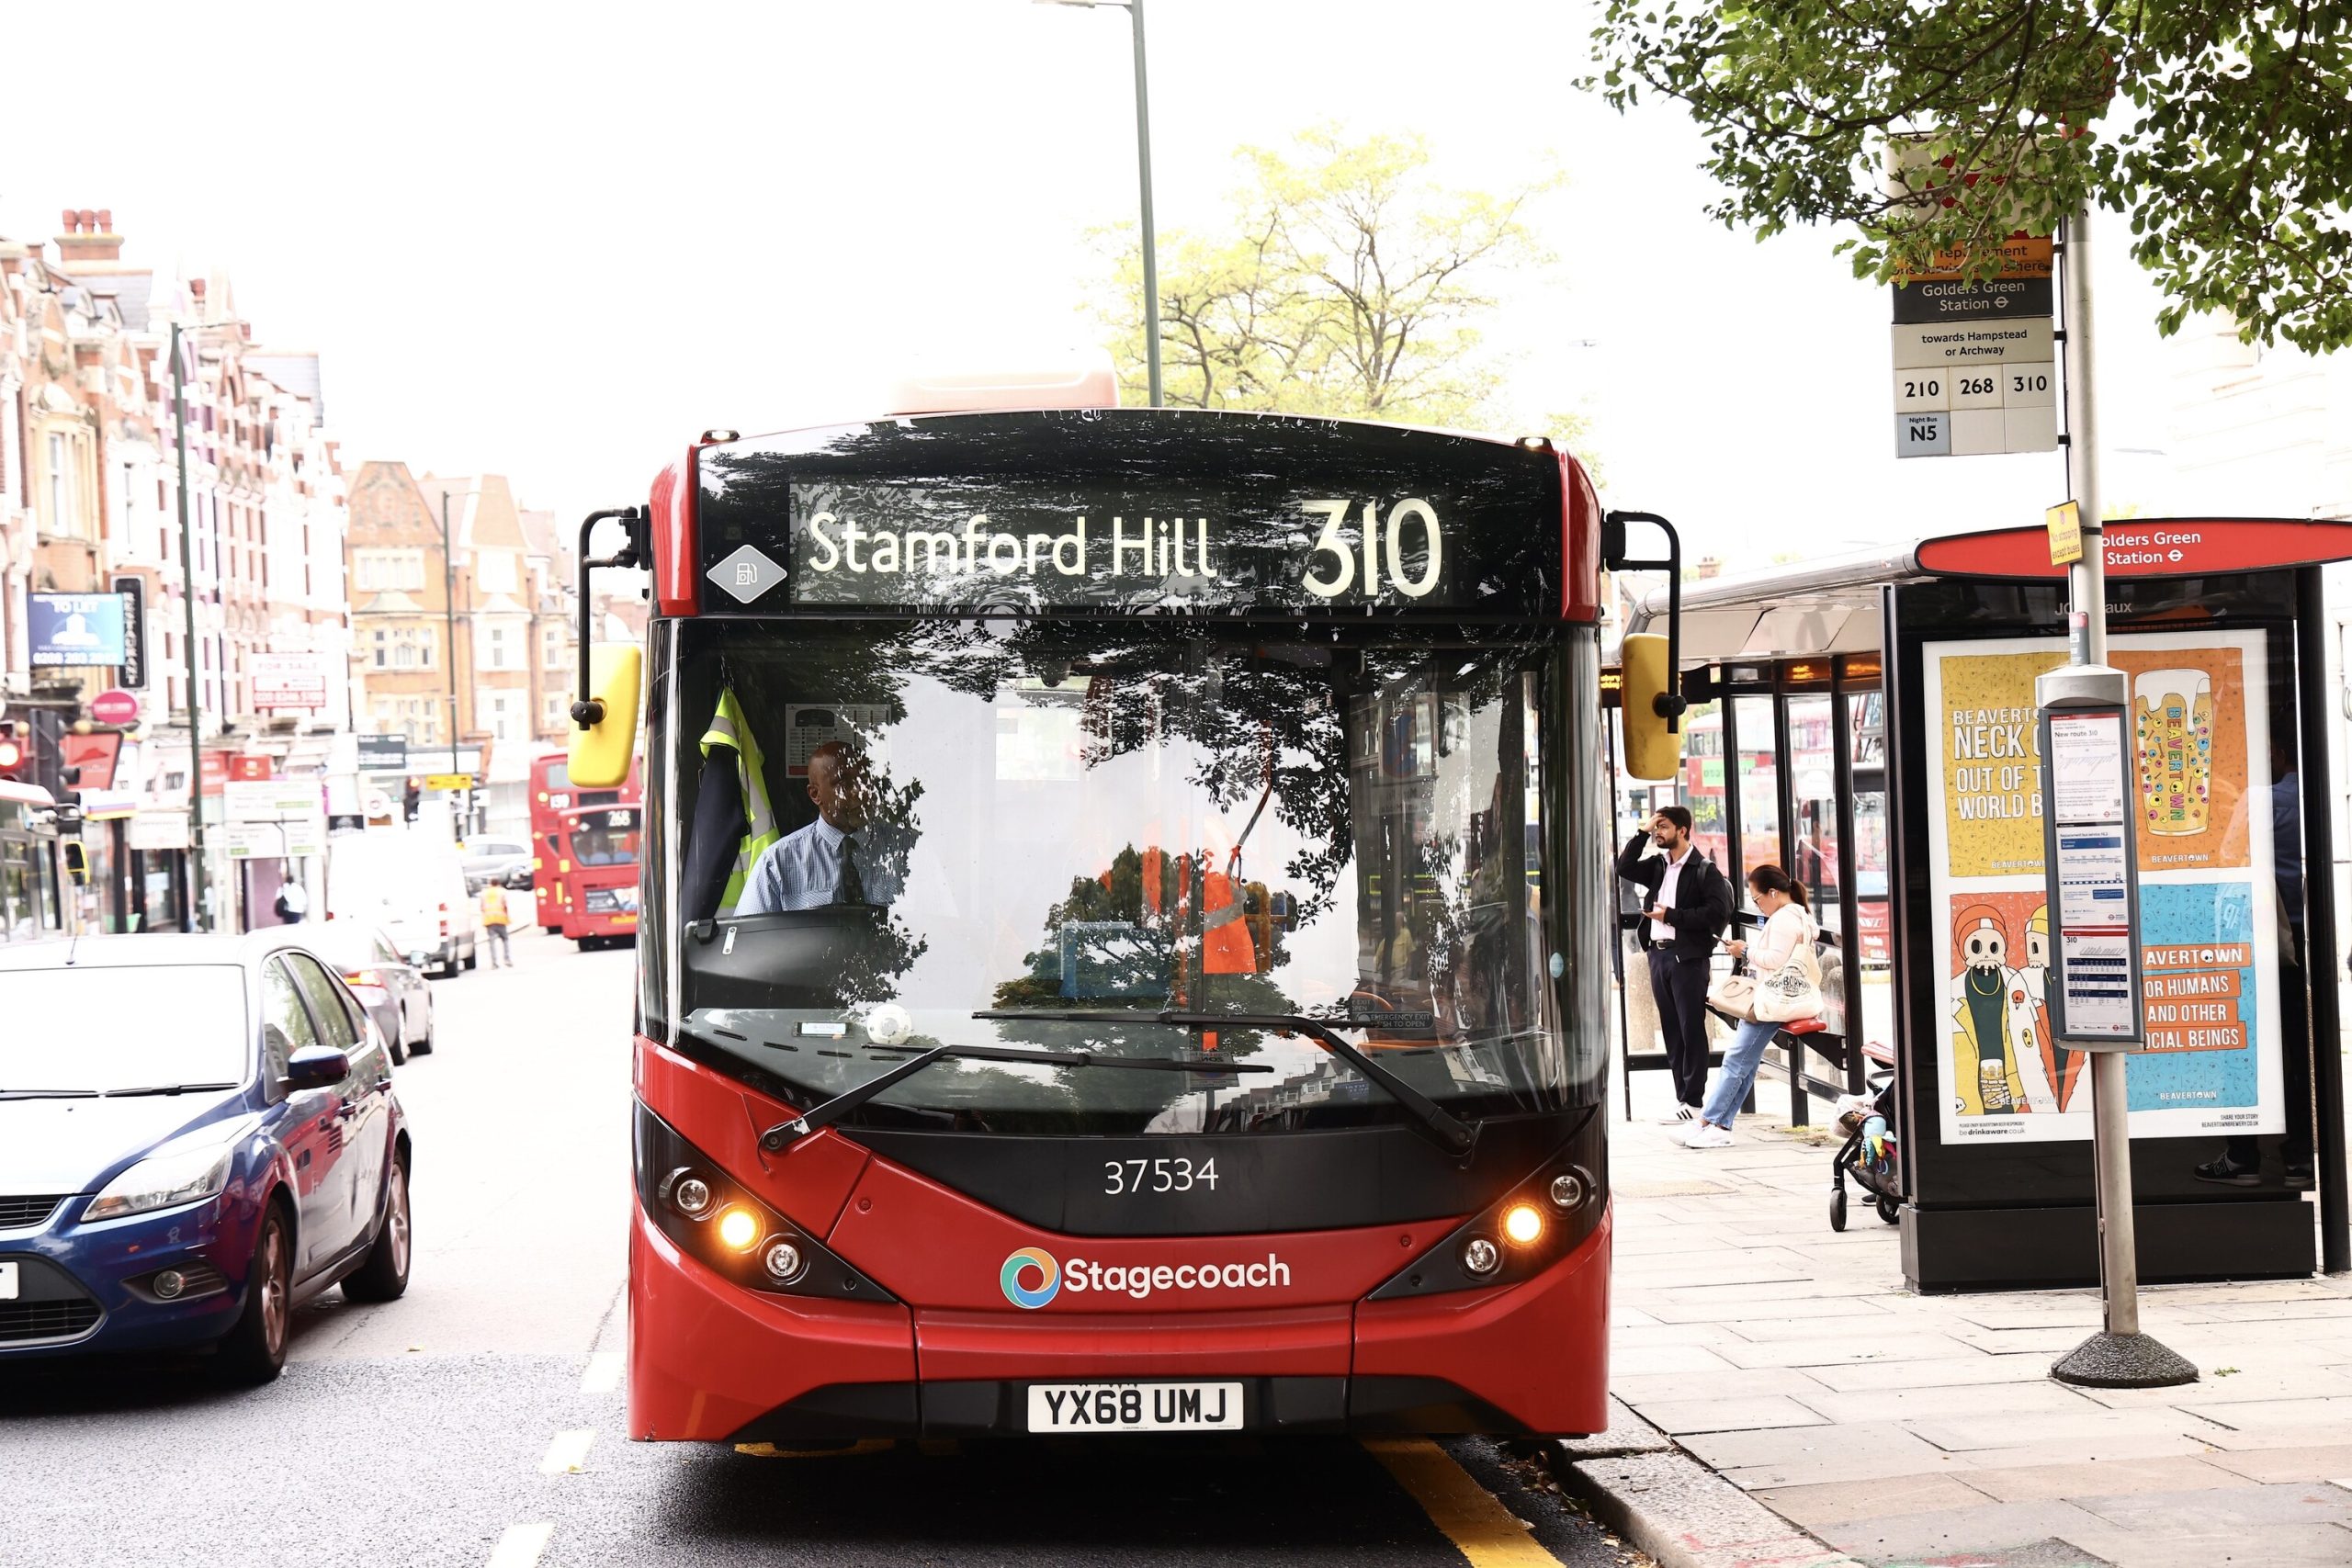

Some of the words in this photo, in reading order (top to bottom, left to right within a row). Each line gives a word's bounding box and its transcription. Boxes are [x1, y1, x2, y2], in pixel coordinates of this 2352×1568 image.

[1983, 281, 2026, 294] Green
[1939, 299, 1990, 311] Station
[1922, 333, 1965, 344] towards
[1967, 329, 2028, 344] Hampstead
[1959, 345, 2005, 356] Archway
[1905, 380, 1939, 398] 210
[1960, 378, 1994, 395] 268
[2013, 375, 2047, 392] 310
[1910, 424, 1937, 442] N5
[808, 511, 1087, 576] Stamford
[1113, 515, 1217, 579] Hill
[1302, 496, 1442, 599] 310
[2102, 534, 2150, 547] olders
[2154, 531, 2201, 546] Green
[2107, 550, 2164, 566] Station
[1954, 723, 2026, 761] NECK
[2166, 706, 2185, 821] BEAVERTOWN
[1956, 766, 1994, 793] OUT
[2001, 765, 2025, 792] OF
[1957, 793, 2024, 820] WORLD
[607, 810, 631, 827] 268
[2152, 853, 2209, 863] BEAVERTOWN
[2066, 936, 2078, 944] 310
[2167, 976, 2230, 997] HUMANS
[2147, 1004, 2177, 1022] AND
[2181, 1003, 2227, 1022] OTHER
[2188, 1028, 2239, 1048] BEINGS
[2160, 1090, 2217, 1100] BEAVERTOWN
[1104, 1156, 1219, 1195] 37534
[1063, 1252, 1291, 1299] Stagecoach
[1045, 1388, 1142, 1426] YX68
[1154, 1388, 1227, 1424] UMJ
